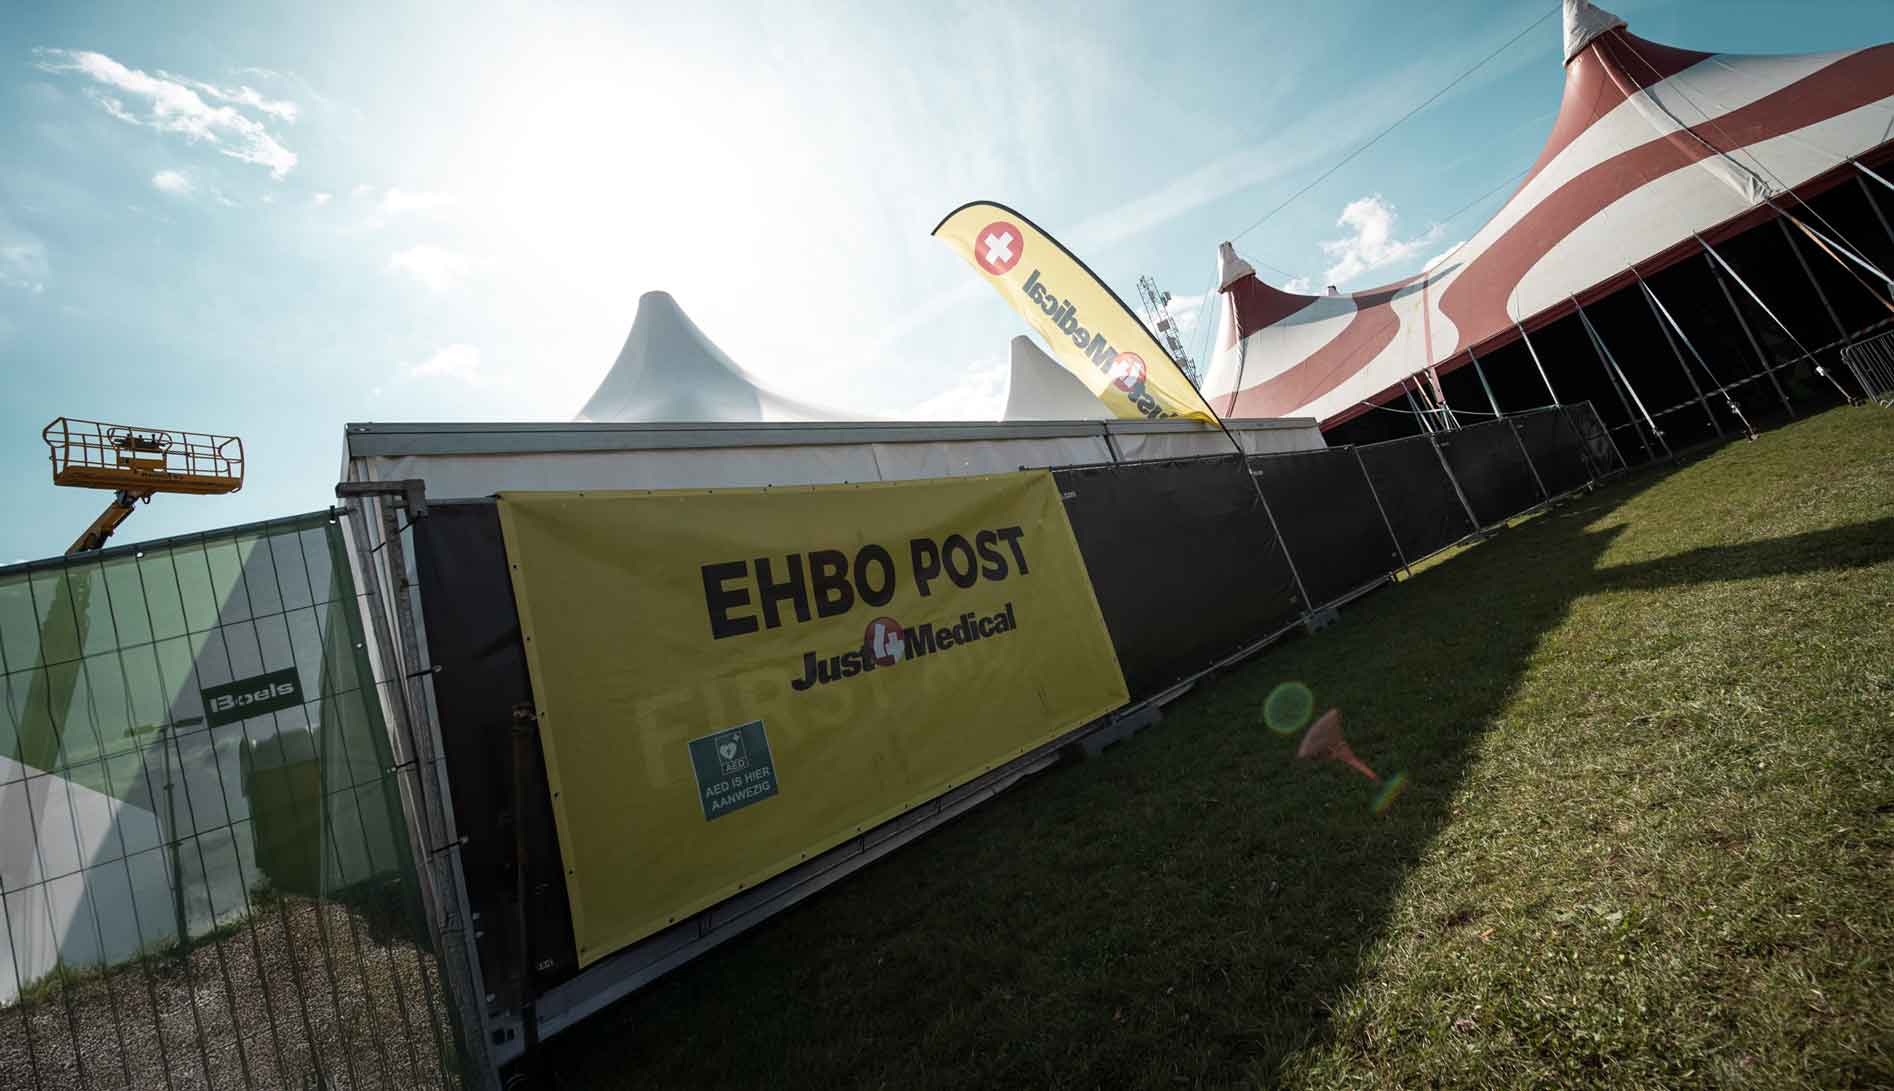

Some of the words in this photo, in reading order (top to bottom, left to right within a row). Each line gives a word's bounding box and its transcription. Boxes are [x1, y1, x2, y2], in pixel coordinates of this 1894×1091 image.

[700, 543, 896, 640] EHBO
[909, 526, 1032, 597] POST
[209, 682, 294, 712] Boels
[726, 759, 745, 771] AED
[706, 782, 729, 798] AED
[731, 776, 743, 788] IS
[745, 767, 769, 782] HIER
[712, 782, 770, 810] AANWEZIG
